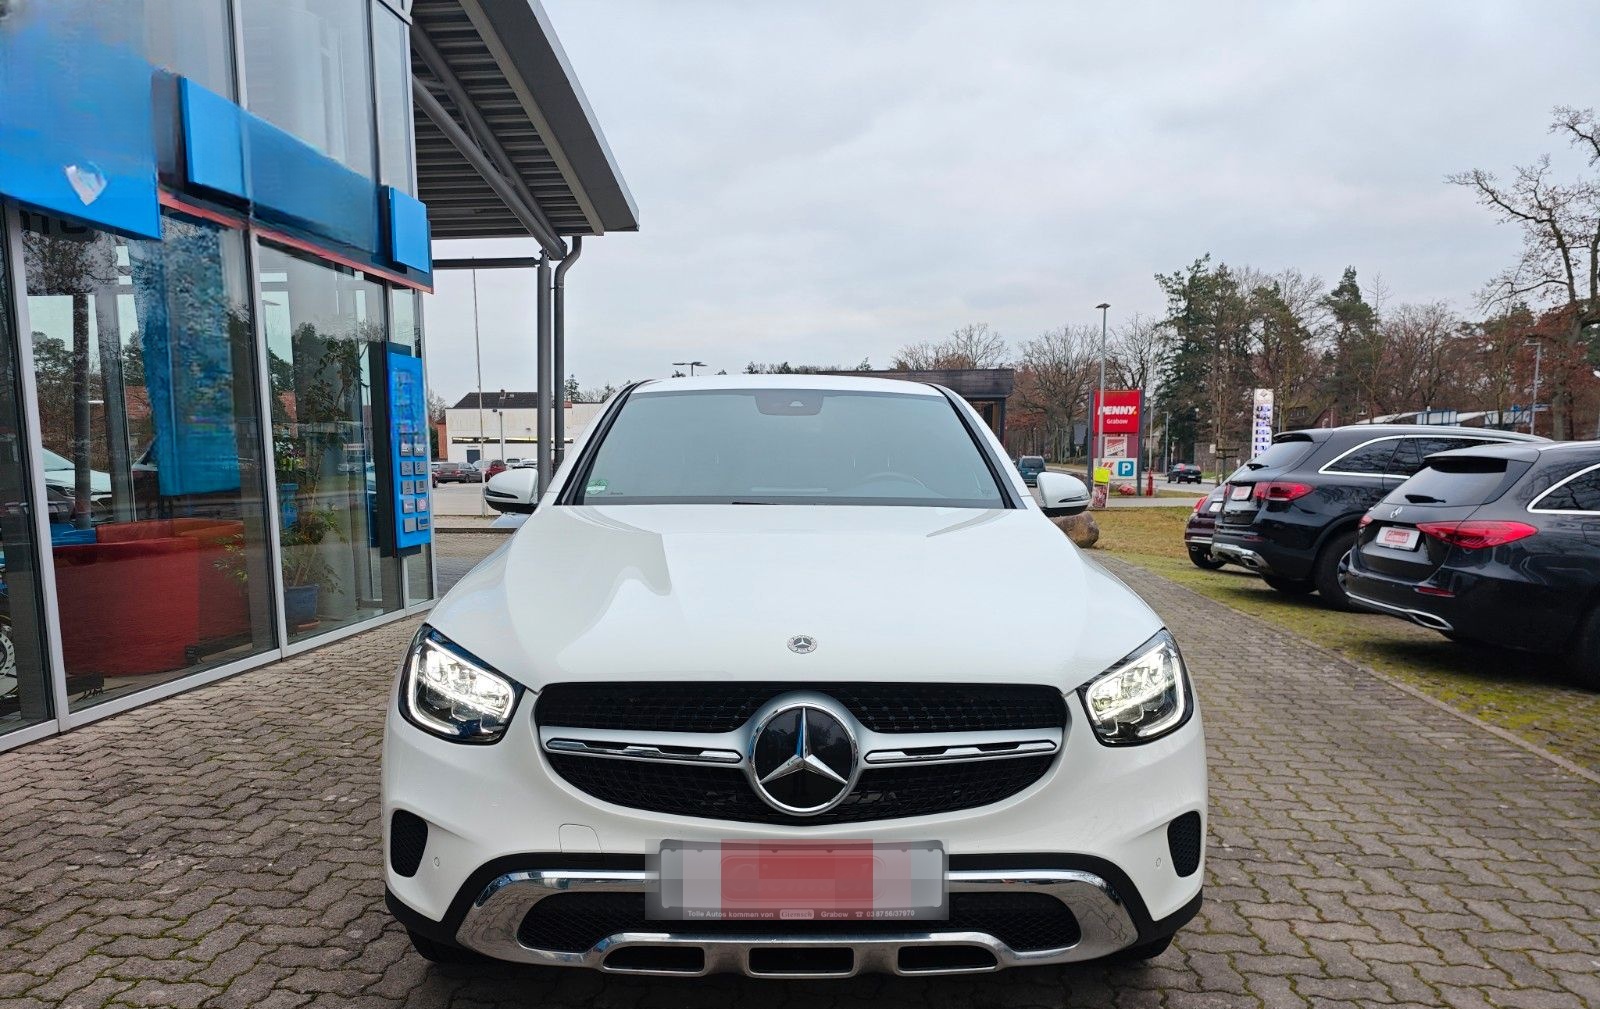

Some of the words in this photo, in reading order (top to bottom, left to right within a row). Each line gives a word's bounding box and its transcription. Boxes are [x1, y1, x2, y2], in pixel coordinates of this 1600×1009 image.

[1122, 463, 1131, 474] P
[687, 910, 705, 918] Tolle
[705, 910, 727, 918] Autos
